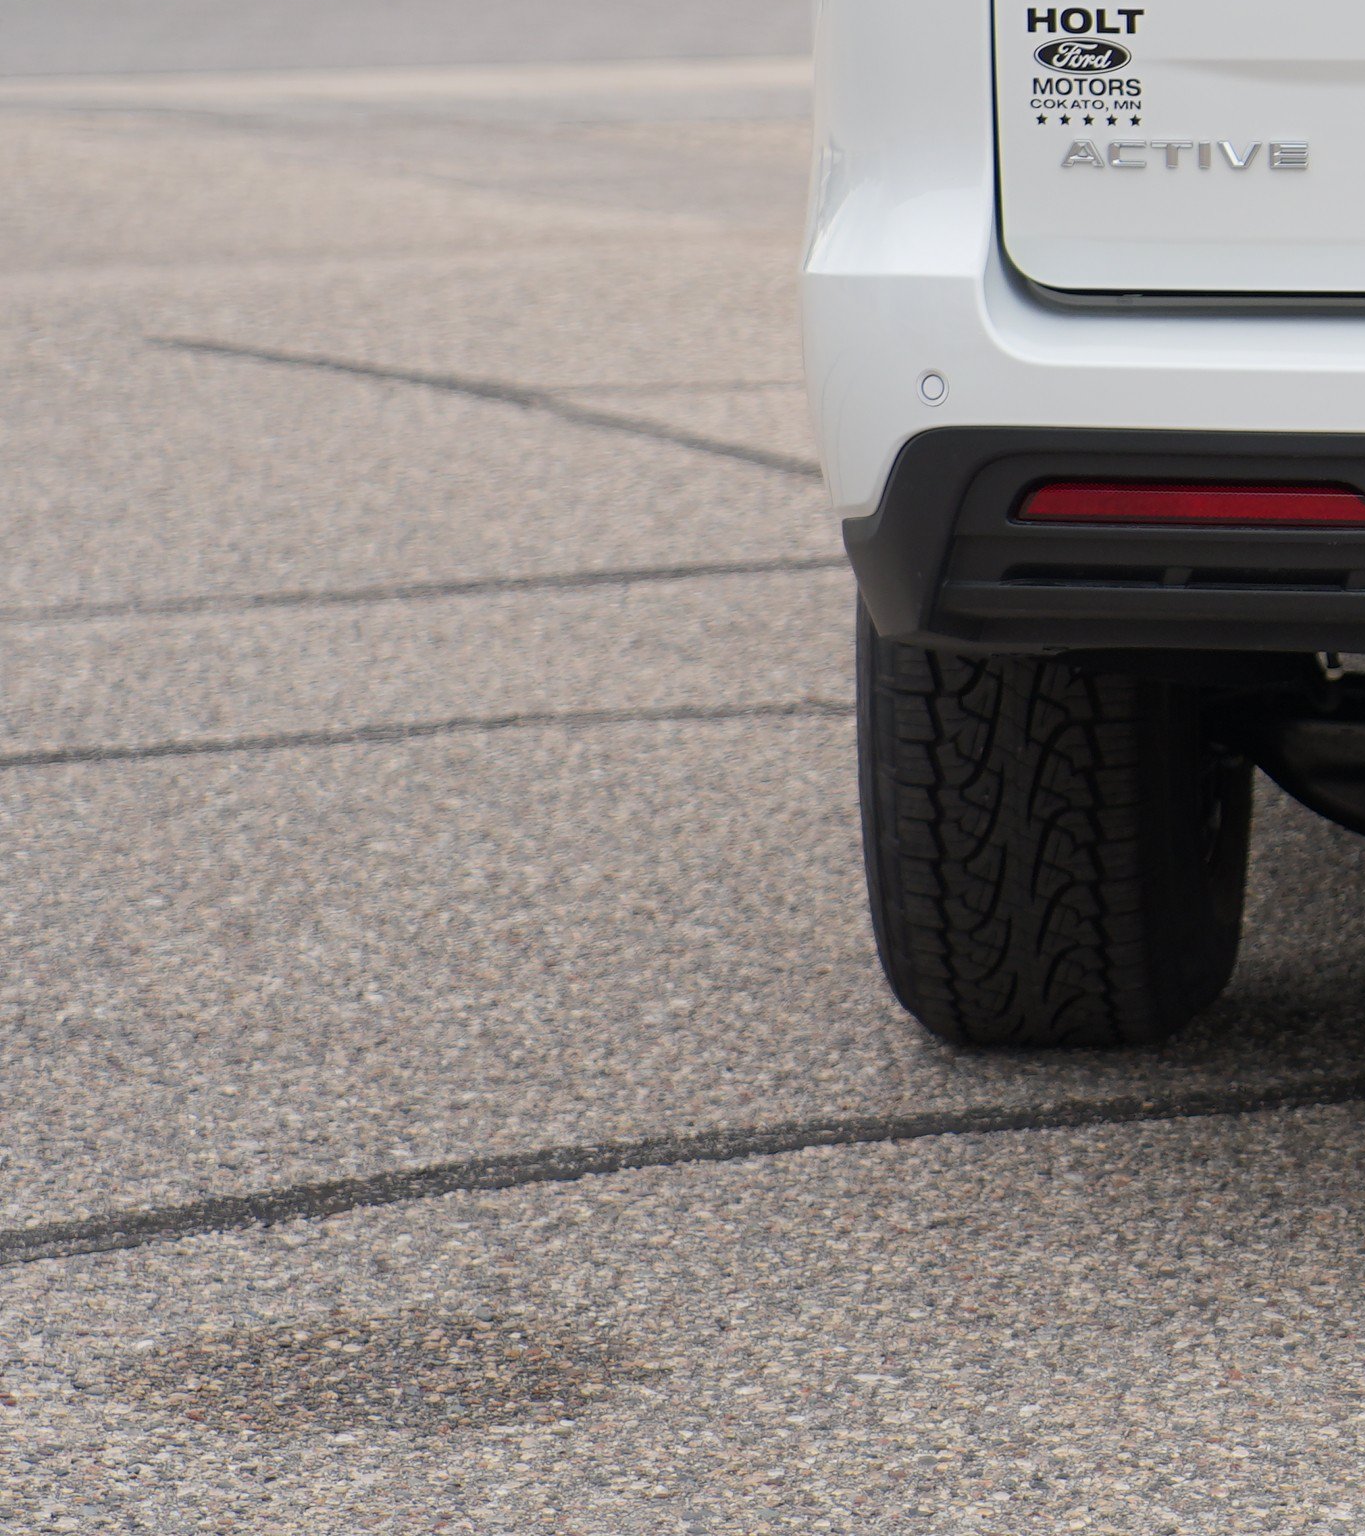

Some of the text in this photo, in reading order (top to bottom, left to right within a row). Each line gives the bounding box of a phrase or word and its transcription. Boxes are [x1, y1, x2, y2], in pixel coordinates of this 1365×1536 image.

[1027, 7, 1144, 34] HOLT
[1052, 42, 1113, 69] Ford
[1032, 78, 1142, 96] MOTORS
[1030, 99, 1142, 112] COKATO, MN
[1061, 138, 1309, 169] ACTIVE
